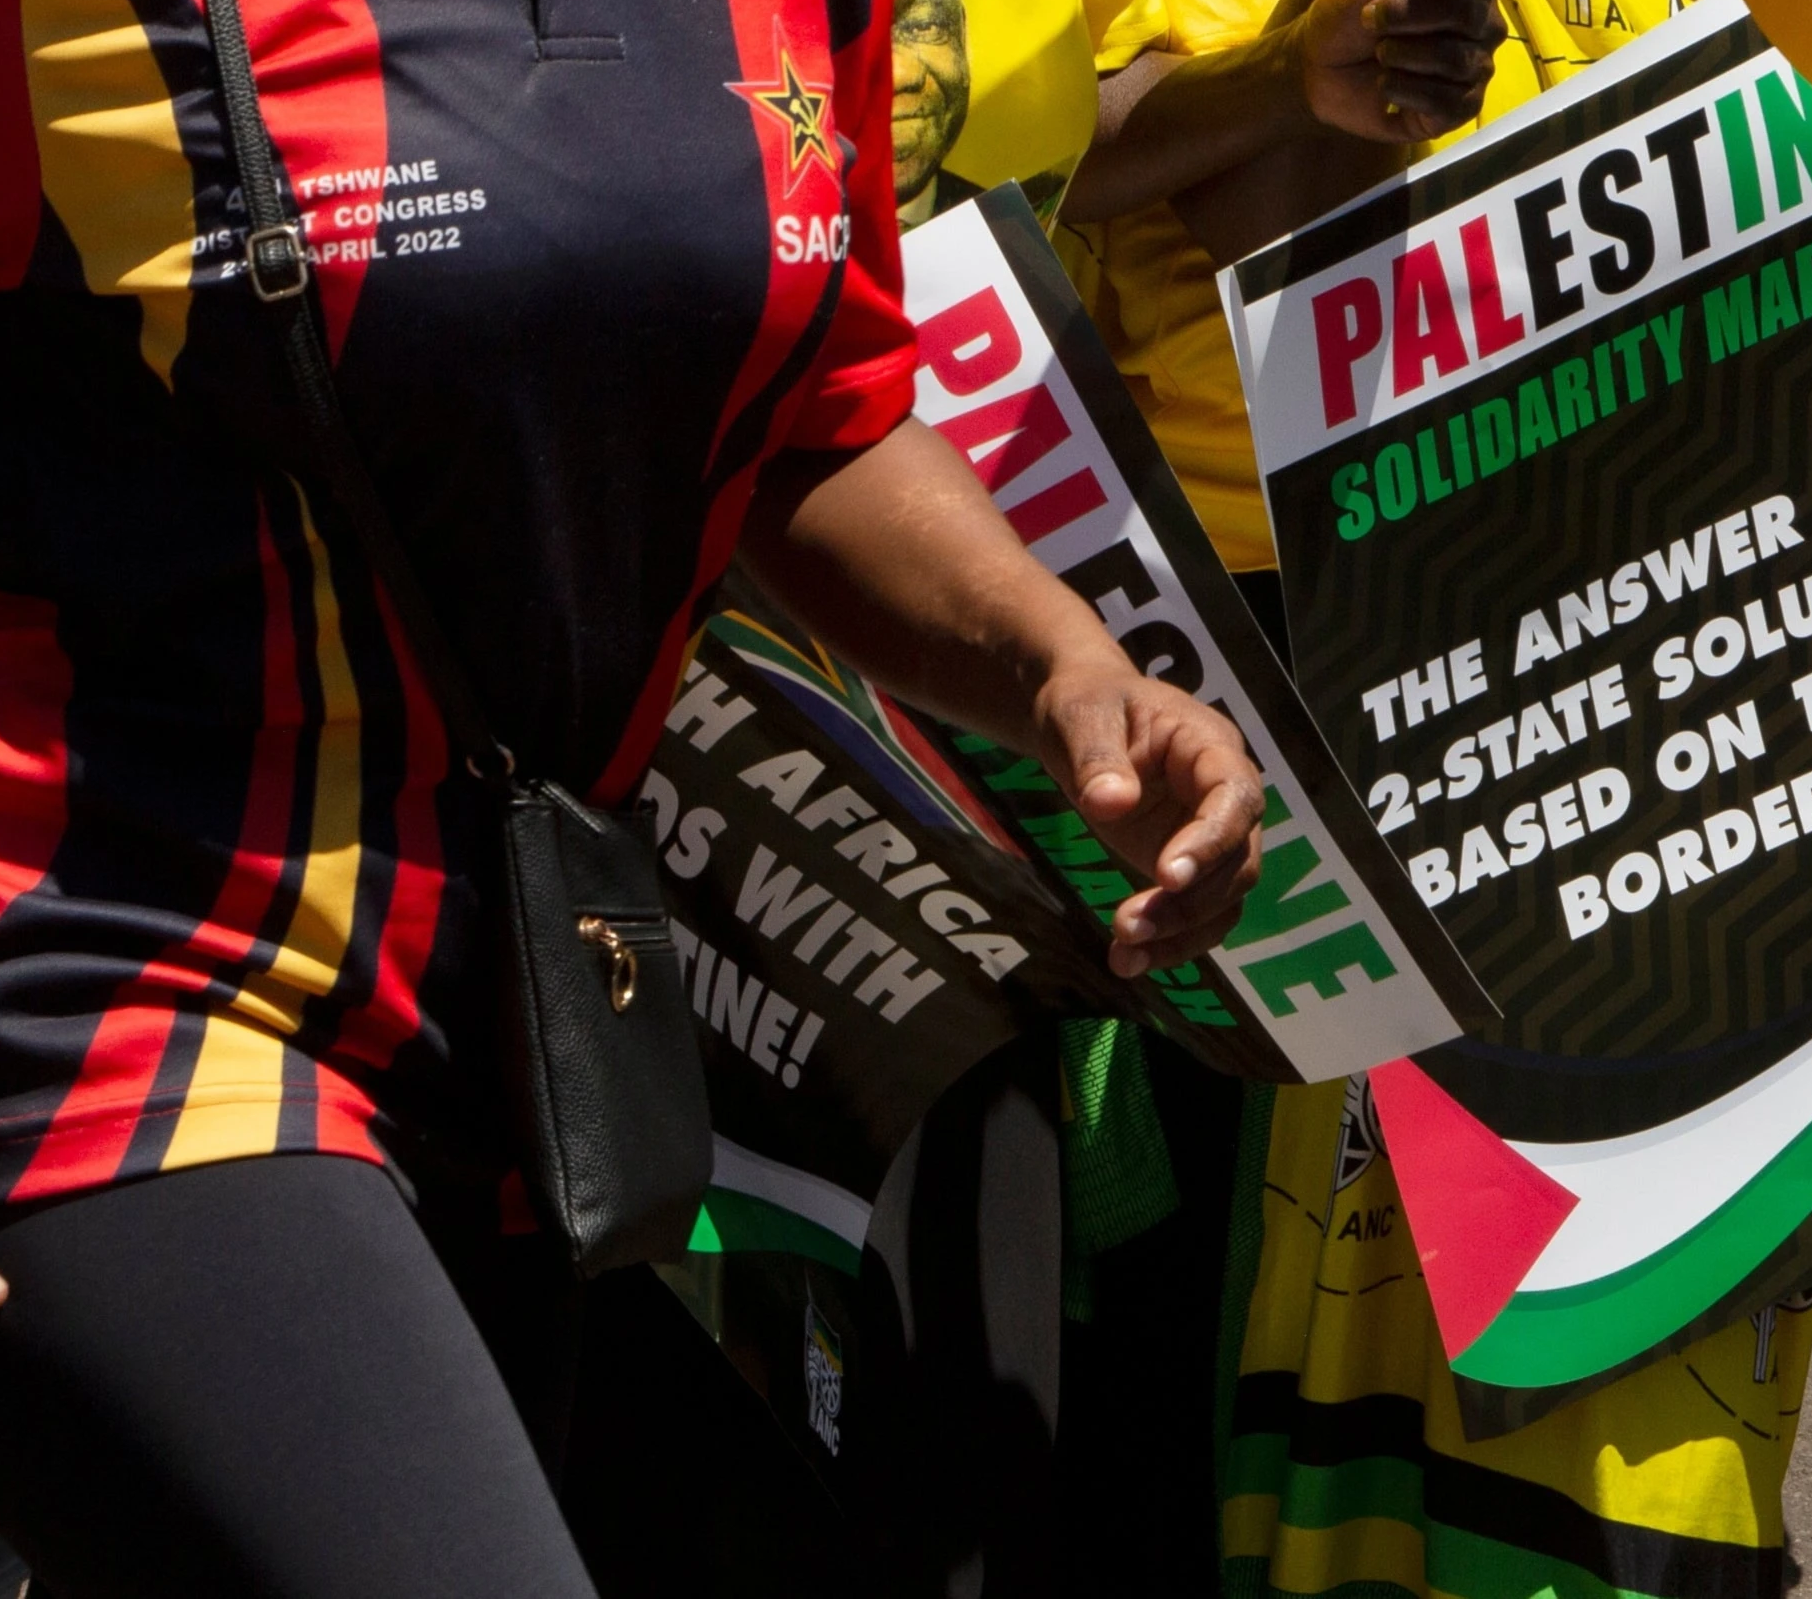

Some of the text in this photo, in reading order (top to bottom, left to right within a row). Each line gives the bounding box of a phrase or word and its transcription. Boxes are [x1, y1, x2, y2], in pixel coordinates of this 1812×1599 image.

[299, 159, 439, 200] TSHWANE
[304, 238, 388, 265] APRIL
[394, 226, 462, 256] 2022
[334, 188, 487, 229] CONGRESS
[1331, 304, 1686, 541] SOLIDARITY
[1361, 638, 1490, 743] THE
[1512, 494, 1805, 676] ANSWER
[1368, 665, 1631, 837] 2-STATE
[1408, 765, 1631, 911] BASED
[1656, 703, 1765, 793] ON
[734, 843, 946, 1025] WITH
[736, 750, 1030, 982] AFRICA
[1337, 1204, 1397, 1242] ANC
